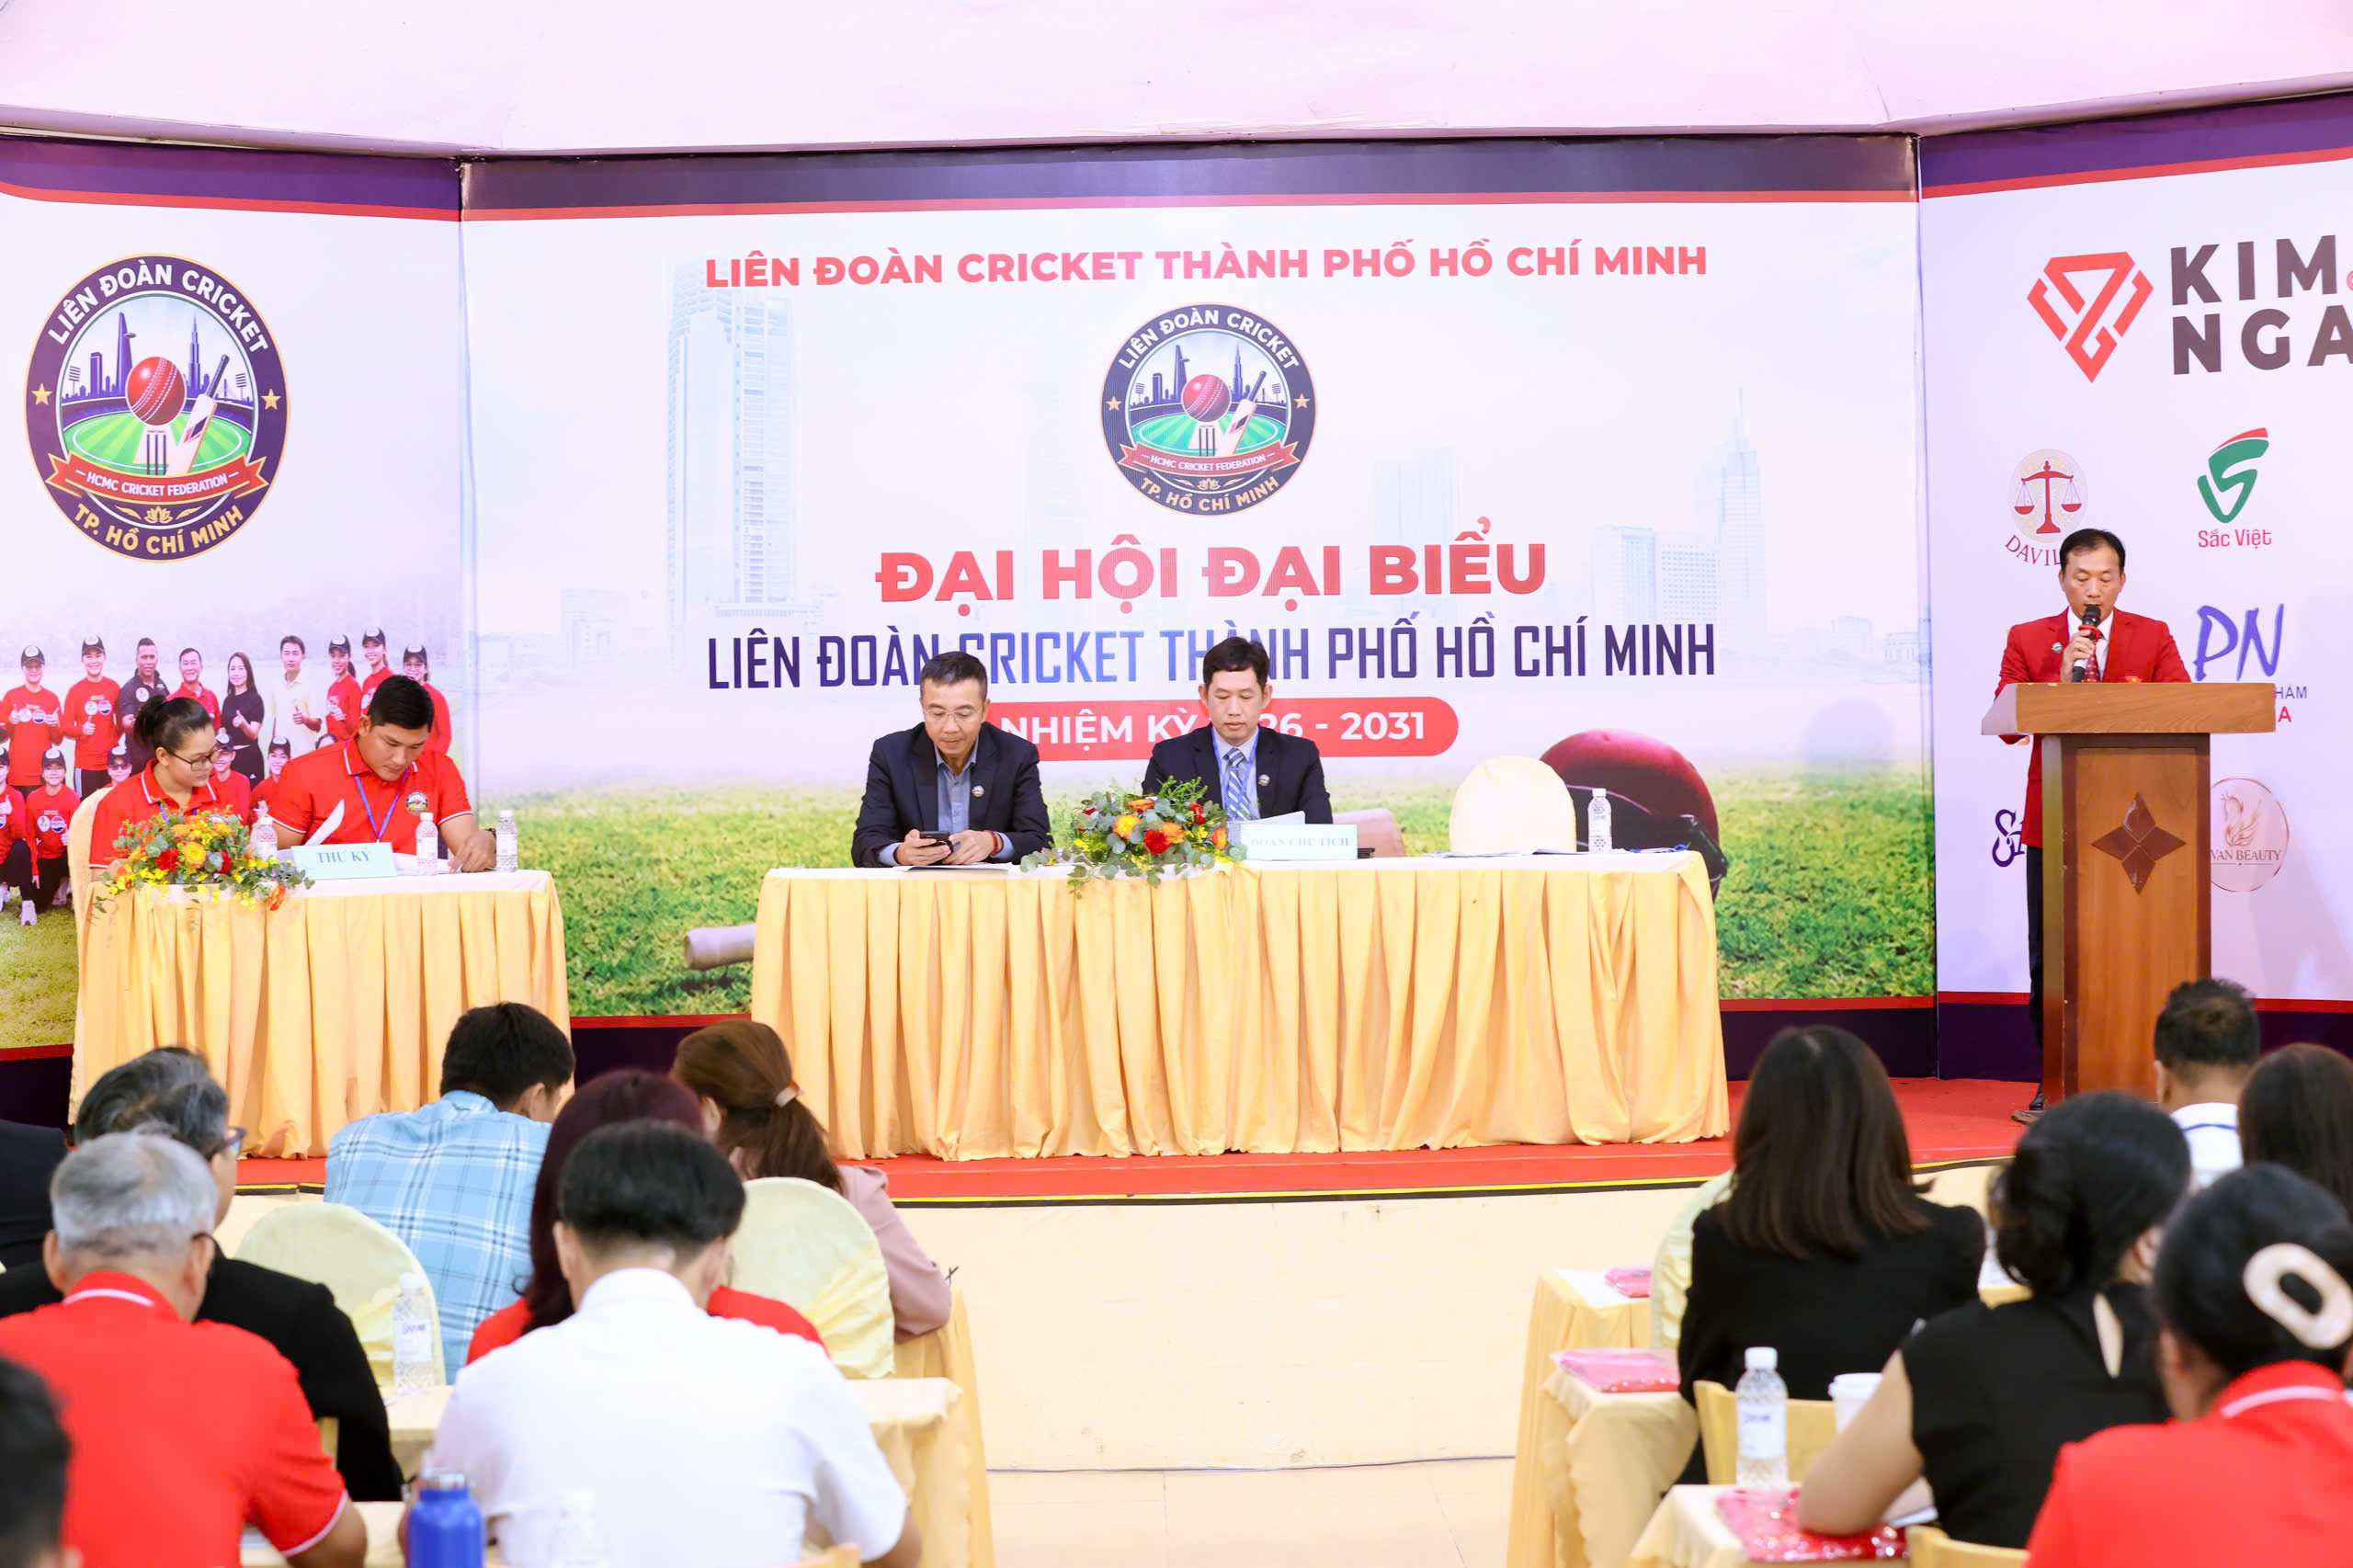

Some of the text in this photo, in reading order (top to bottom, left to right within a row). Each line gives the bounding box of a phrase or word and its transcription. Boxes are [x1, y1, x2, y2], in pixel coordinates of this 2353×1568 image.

[706, 237, 1707, 288] LIÊN ĐOÀN CRICKET THÀNH PHỐ HỒ CHÍ MINH
[2170, 234, 2337, 306] KIM
[48, 259, 269, 355] LIÊN ĐOÀN CRICKET
[1118, 307, 1300, 369] LIÊN ĐOÀN CRICKET
[2173, 304, 2353, 375] NGA
[85, 471, 229, 496] HCMC CRICKET FEDERATION
[1150, 453, 1267, 472] HCMC CRICKET FEDERATION
[1140, 475, 1280, 512] TP. HỒ CHÍ MINH
[74, 503, 244, 554] TP. HỒ CHÍ MINH
[2005, 534, 2061, 566] DAVIL
[2198, 528, 2272, 550] Sắc Việt
[875, 516, 1546, 617] ĐẠI HỘI ĐẠI BIỂU
[708, 627, 801, 690] LIÊN
[1328, 610, 1418, 679] PHỐ
[1436, 610, 1495, 679] HỒ
[1514, 615, 1588, 677] CHÍ
[1605, 623, 1715, 676] MINH
[2192, 602, 2284, 681] PN
[1340, 711, 1425, 740] 2031
[2235, 849, 2281, 861] BEAUTY
